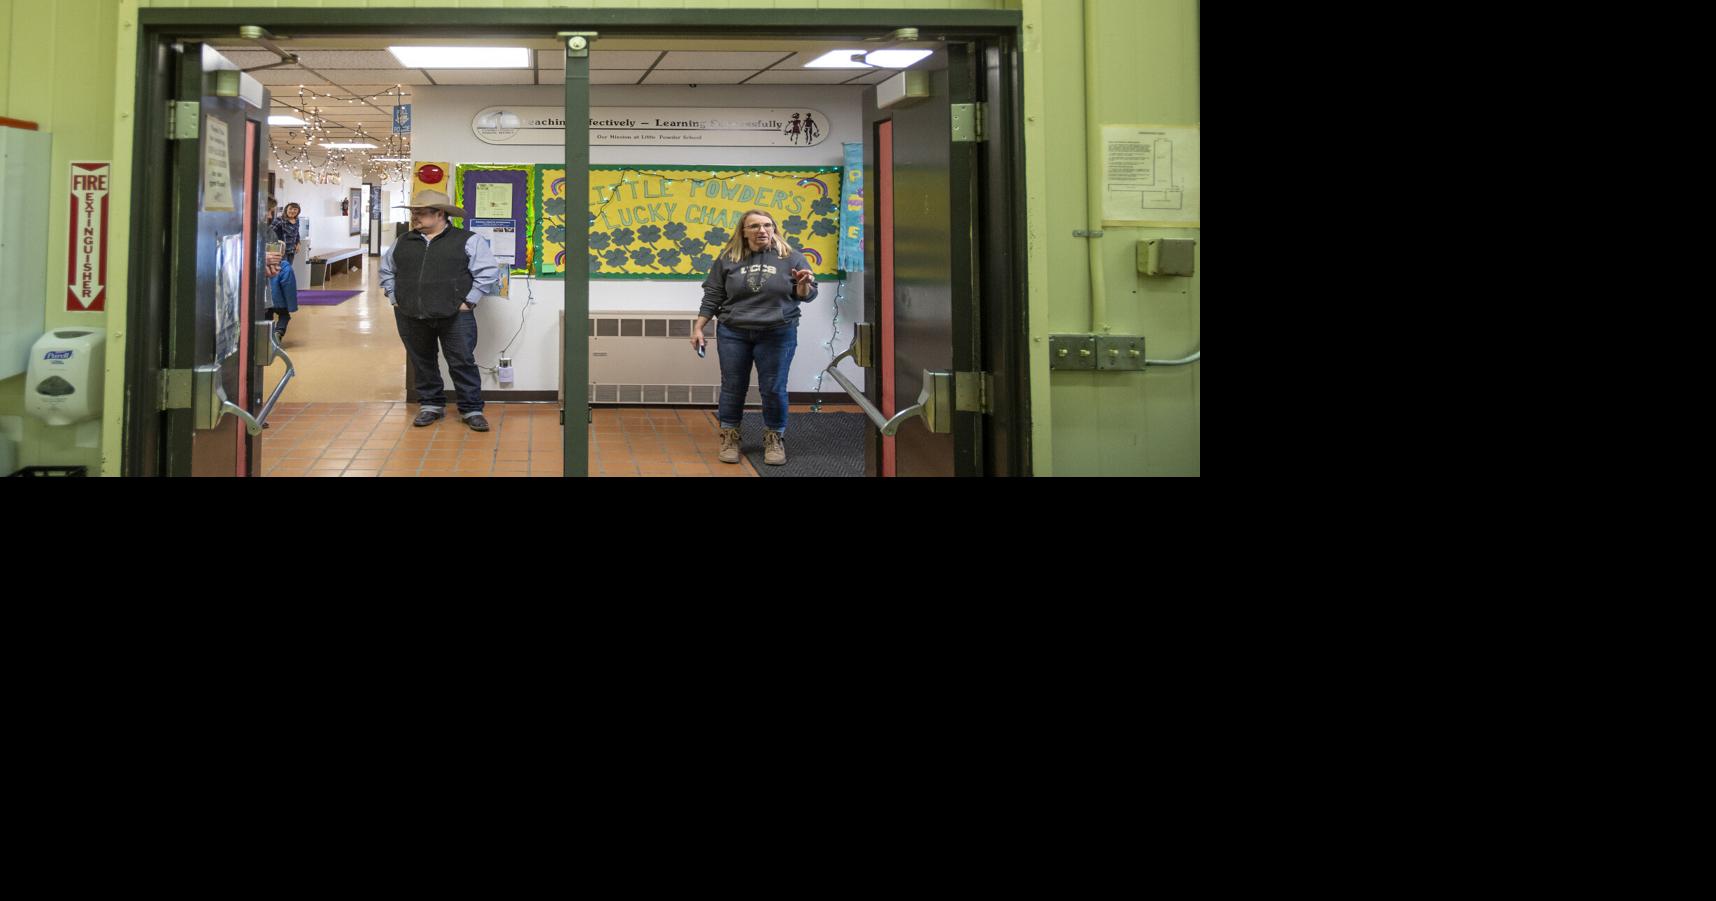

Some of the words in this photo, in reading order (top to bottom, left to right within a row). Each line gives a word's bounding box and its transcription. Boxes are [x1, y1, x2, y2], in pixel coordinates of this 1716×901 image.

[589, 118, 635, 128] fectively
[655, 118, 706, 129] Learning
[73, 174, 107, 191] FIRE
[590, 178, 674, 206] ITTLE
[690, 180, 805, 214] POWDER'S
[601, 202, 678, 230] LUCKY
[82, 192, 94, 298] EXTINGUISHER
